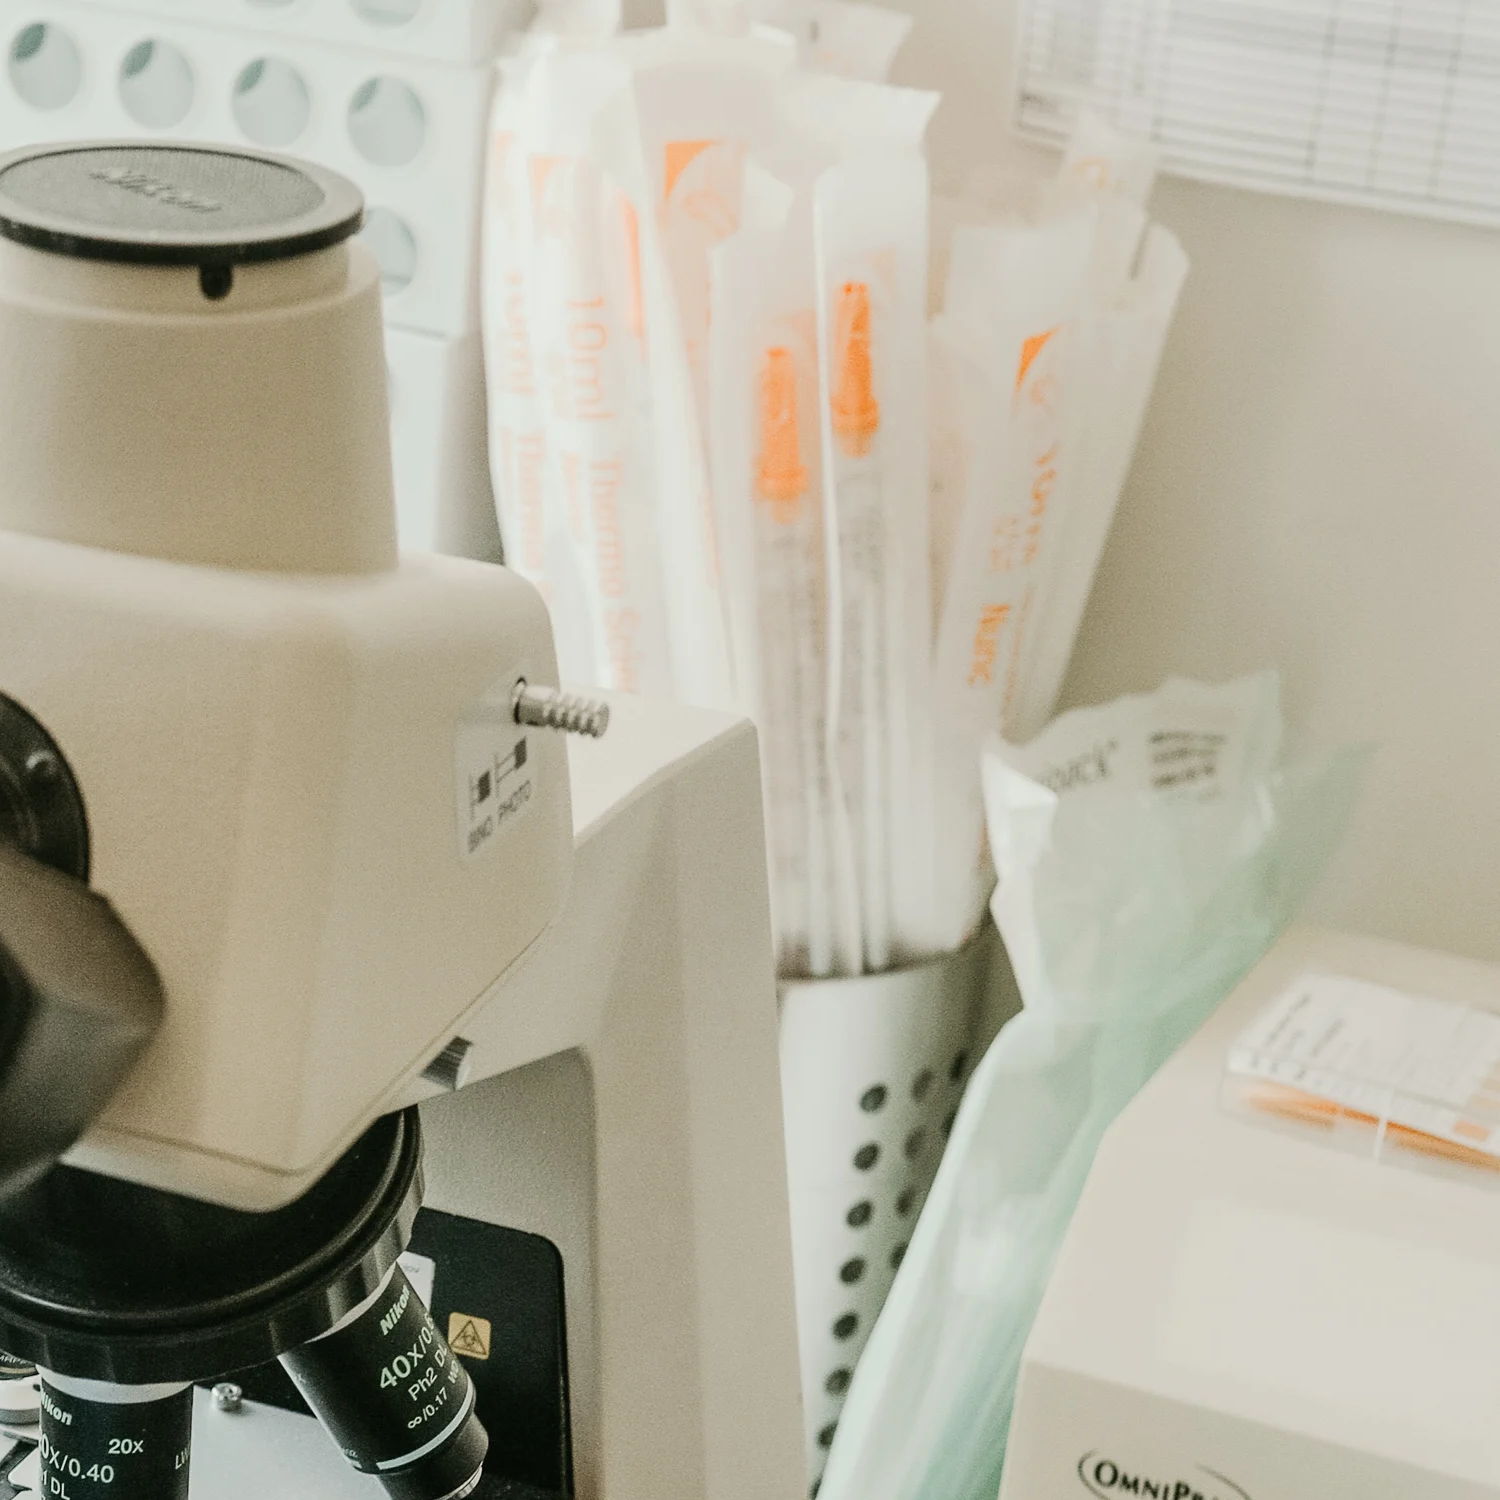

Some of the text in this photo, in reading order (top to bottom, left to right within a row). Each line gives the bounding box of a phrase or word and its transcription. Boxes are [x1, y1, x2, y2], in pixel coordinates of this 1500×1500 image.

[380, 1284, 410, 1336] Nikon
[408, 1367, 438, 1401] Ph2
[51, 1476, 71, 1500] DL
